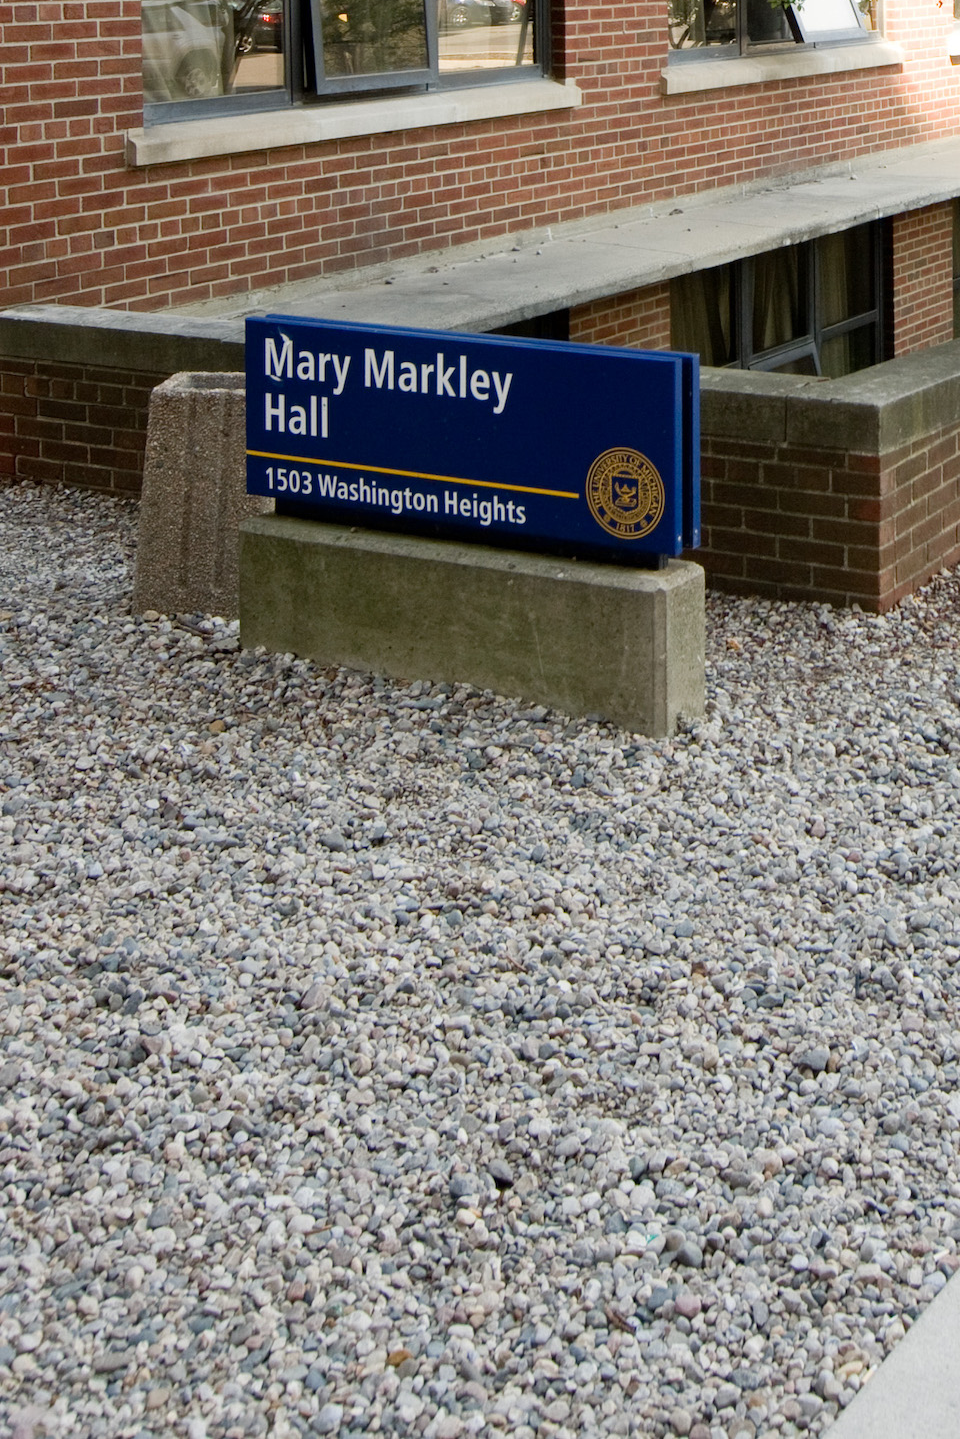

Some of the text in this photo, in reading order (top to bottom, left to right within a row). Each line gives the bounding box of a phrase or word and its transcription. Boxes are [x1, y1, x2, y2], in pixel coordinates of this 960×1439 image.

[264, 337, 513, 414] Mary Markley
[265, 392, 328, 438] Hall
[592, 454, 629, 488] UNIVERSITY
[629, 456, 641, 466] OF
[264, 466, 527, 526] 1503 Washington Heights
[592, 492, 602, 508] THE
[642, 465, 659, 518] MICHIGAN
[616, 523, 635, 533] 1817
